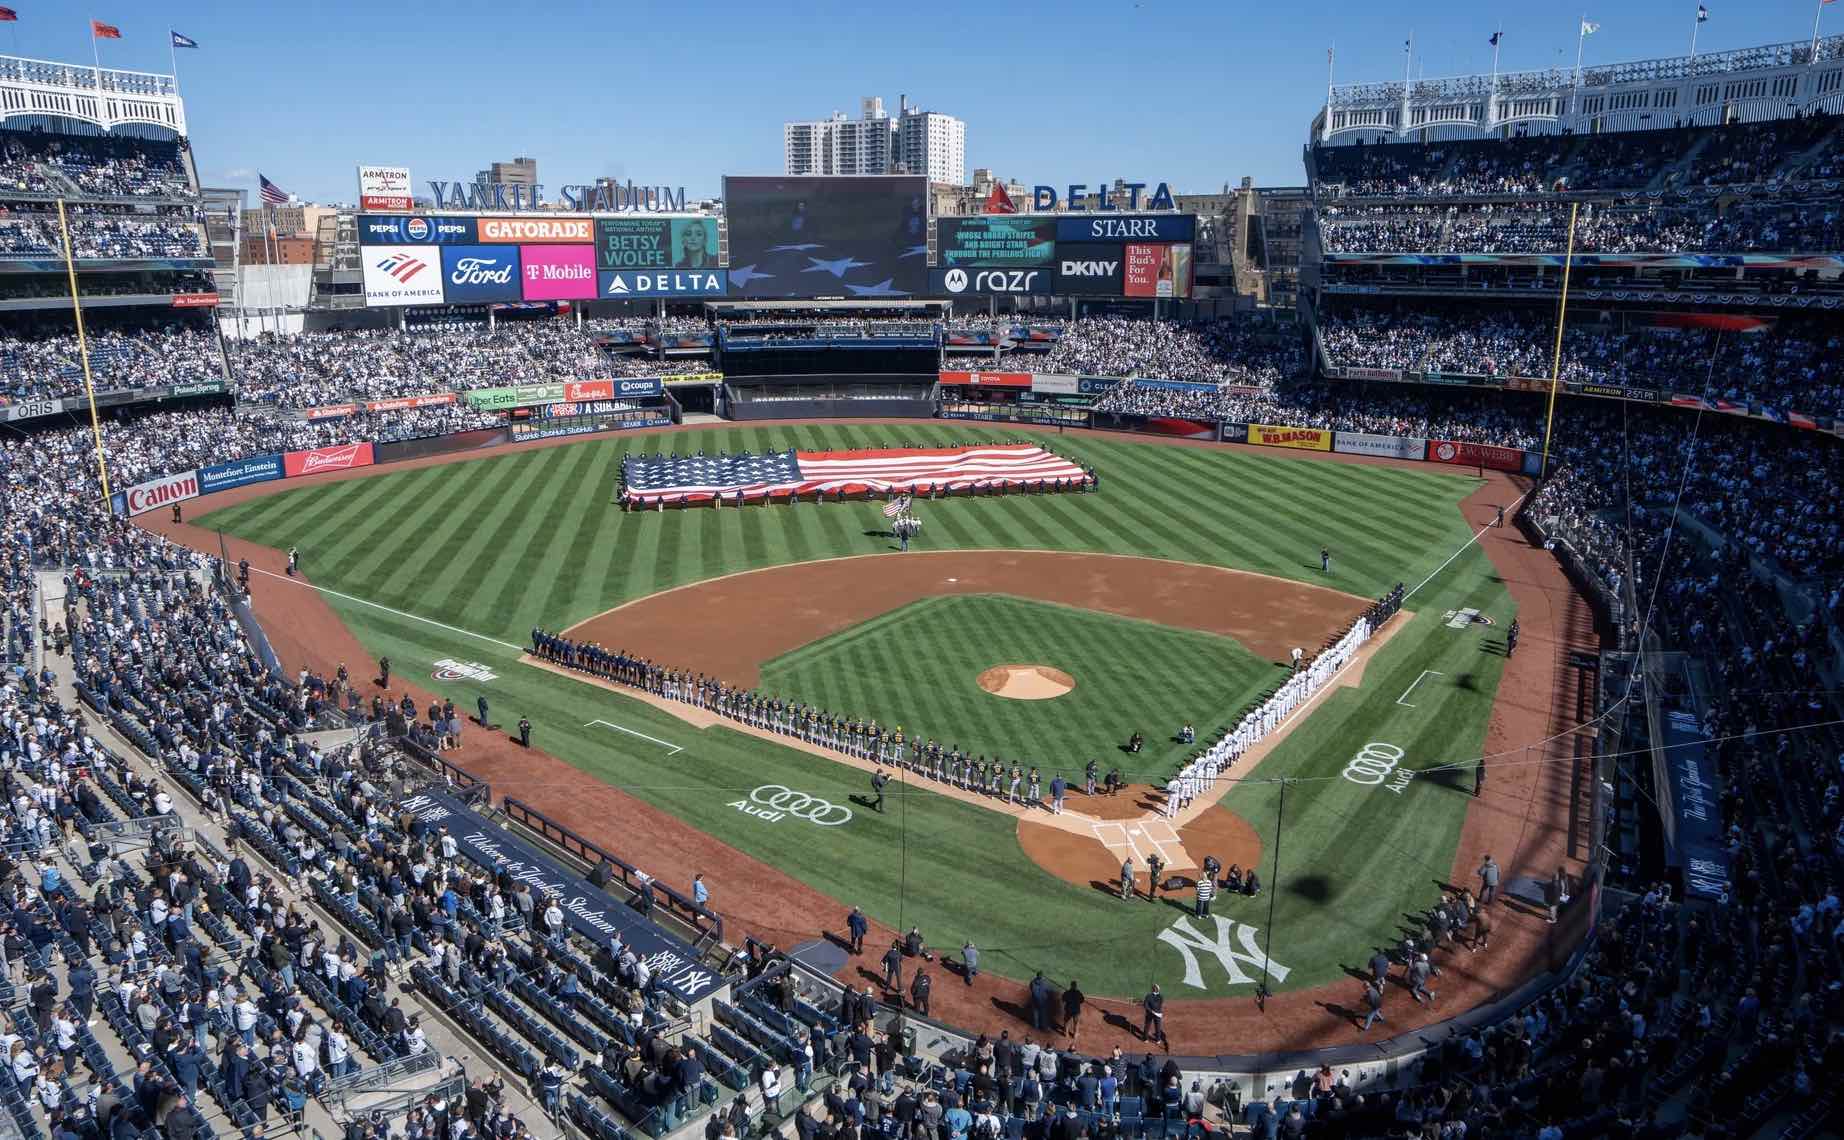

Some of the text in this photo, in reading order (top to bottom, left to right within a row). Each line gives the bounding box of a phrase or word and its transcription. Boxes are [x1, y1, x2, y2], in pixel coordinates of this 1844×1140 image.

[362, 170, 408, 180] ARMITRON
[367, 197, 408, 206] ARMITRON
[426, 180, 686, 213] YANKEE STADIUM
[1033, 182, 1177, 210] DELTA
[369, 224, 399, 233] PEPSI
[438, 224, 466, 234] PEPSI
[485, 221, 590, 239] GATORADE
[1091, 219, 1160, 238] STARR
[608, 235, 660, 250] BETSY
[1129, 245, 1152, 255] This
[604, 250, 665, 266] WOLFE
[1129, 255, 1155, 265] Bud's
[451, 257, 513, 286] Ford
[543, 264, 593, 280] Mobile
[1062, 260, 1118, 277] DKNY
[1129, 265, 1145, 274] For
[636, 274, 720, 292] DELTA
[976, 271, 1039, 292] razr
[1129, 274, 1150, 284] You.
[404, 289, 441, 297] AMERICA
[630, 382, 654, 390] coupa
[1583, 386, 1622, 396] ARMITRON
[492, 394, 516, 405] Eats
[17, 401, 54, 418] ORIS
[1369, 442, 1405, 451] AMERICA
[307, 452, 354, 467] Budweiser
[203, 467, 244, 482] Montefiore
[244, 461, 277, 473] Einstein
[129, 476, 198, 512] Canon
[1384, 767, 1416, 795] Audi
[725, 799, 787, 823] Audi
[560, 896, 617, 935] Stadium
[656, 949, 684, 967] NEW
[1156, 912, 1293, 990] NY
[672, 971, 712, 995] NY
